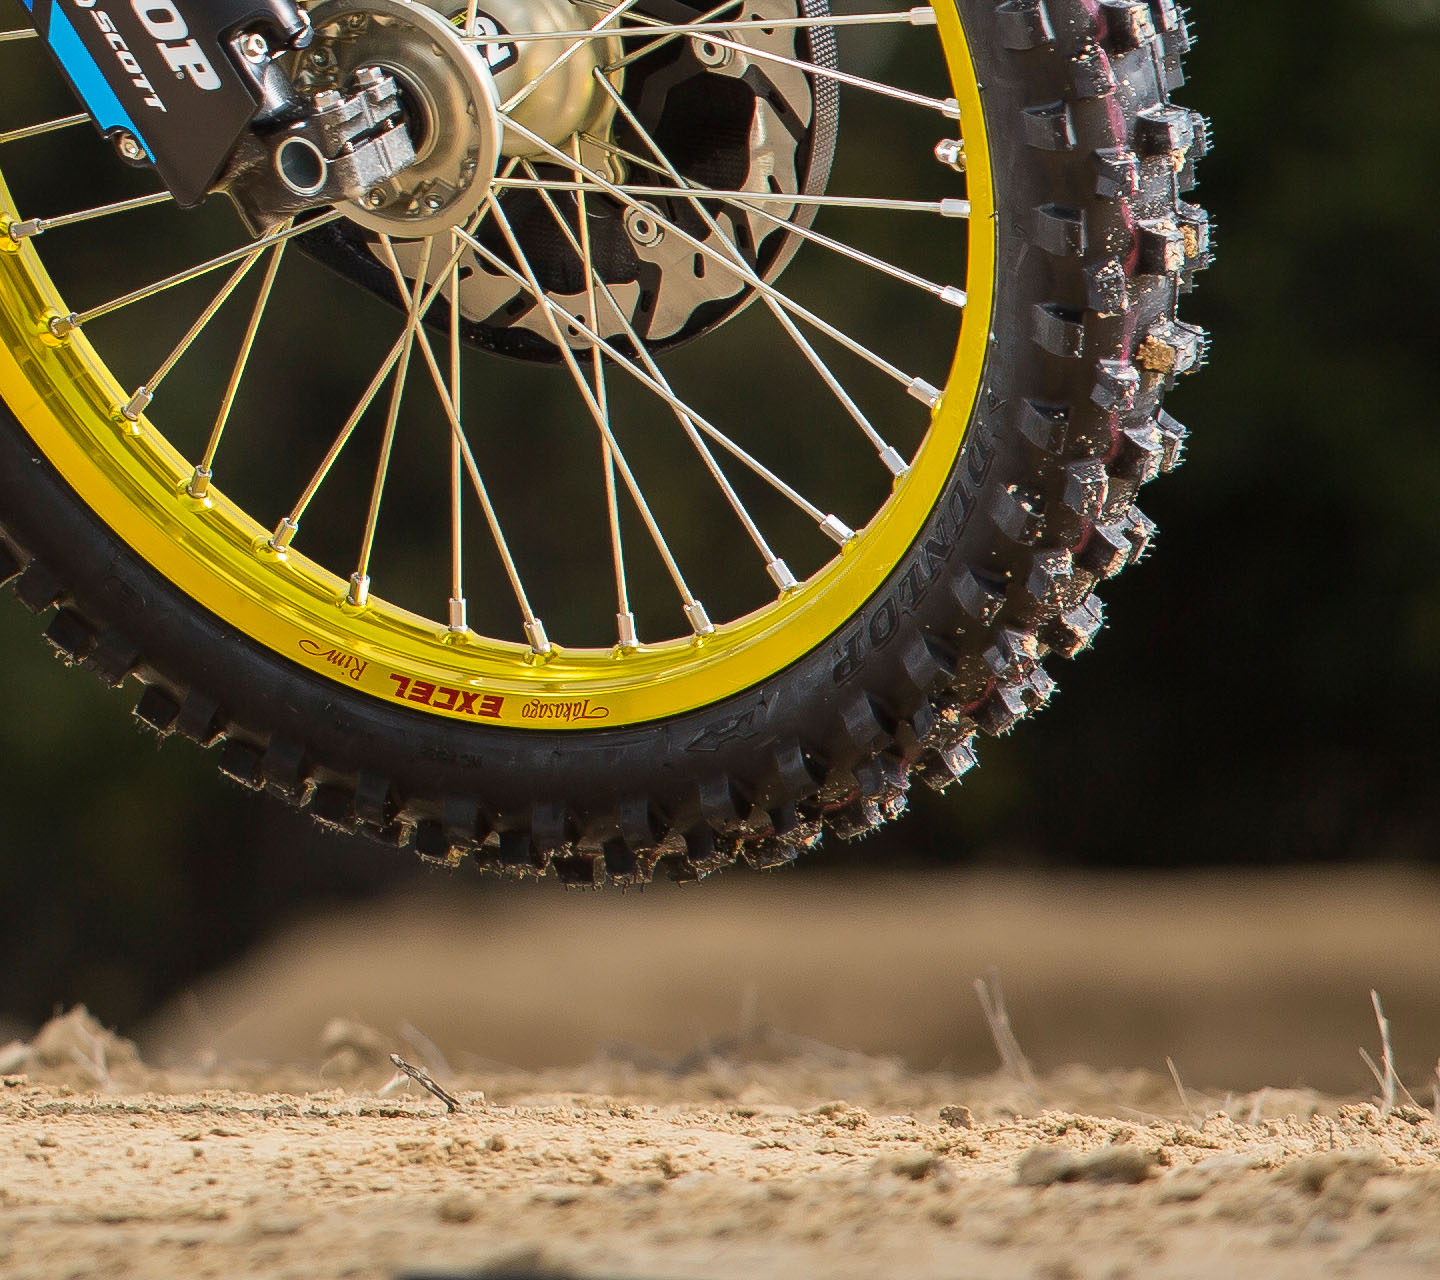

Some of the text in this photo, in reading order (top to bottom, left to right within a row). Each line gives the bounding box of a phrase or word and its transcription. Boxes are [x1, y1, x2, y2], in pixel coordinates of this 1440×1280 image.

[89, 10, 168, 114] SCOTT
[299, 639, 610, 724] Takasago EXCEL Rim
